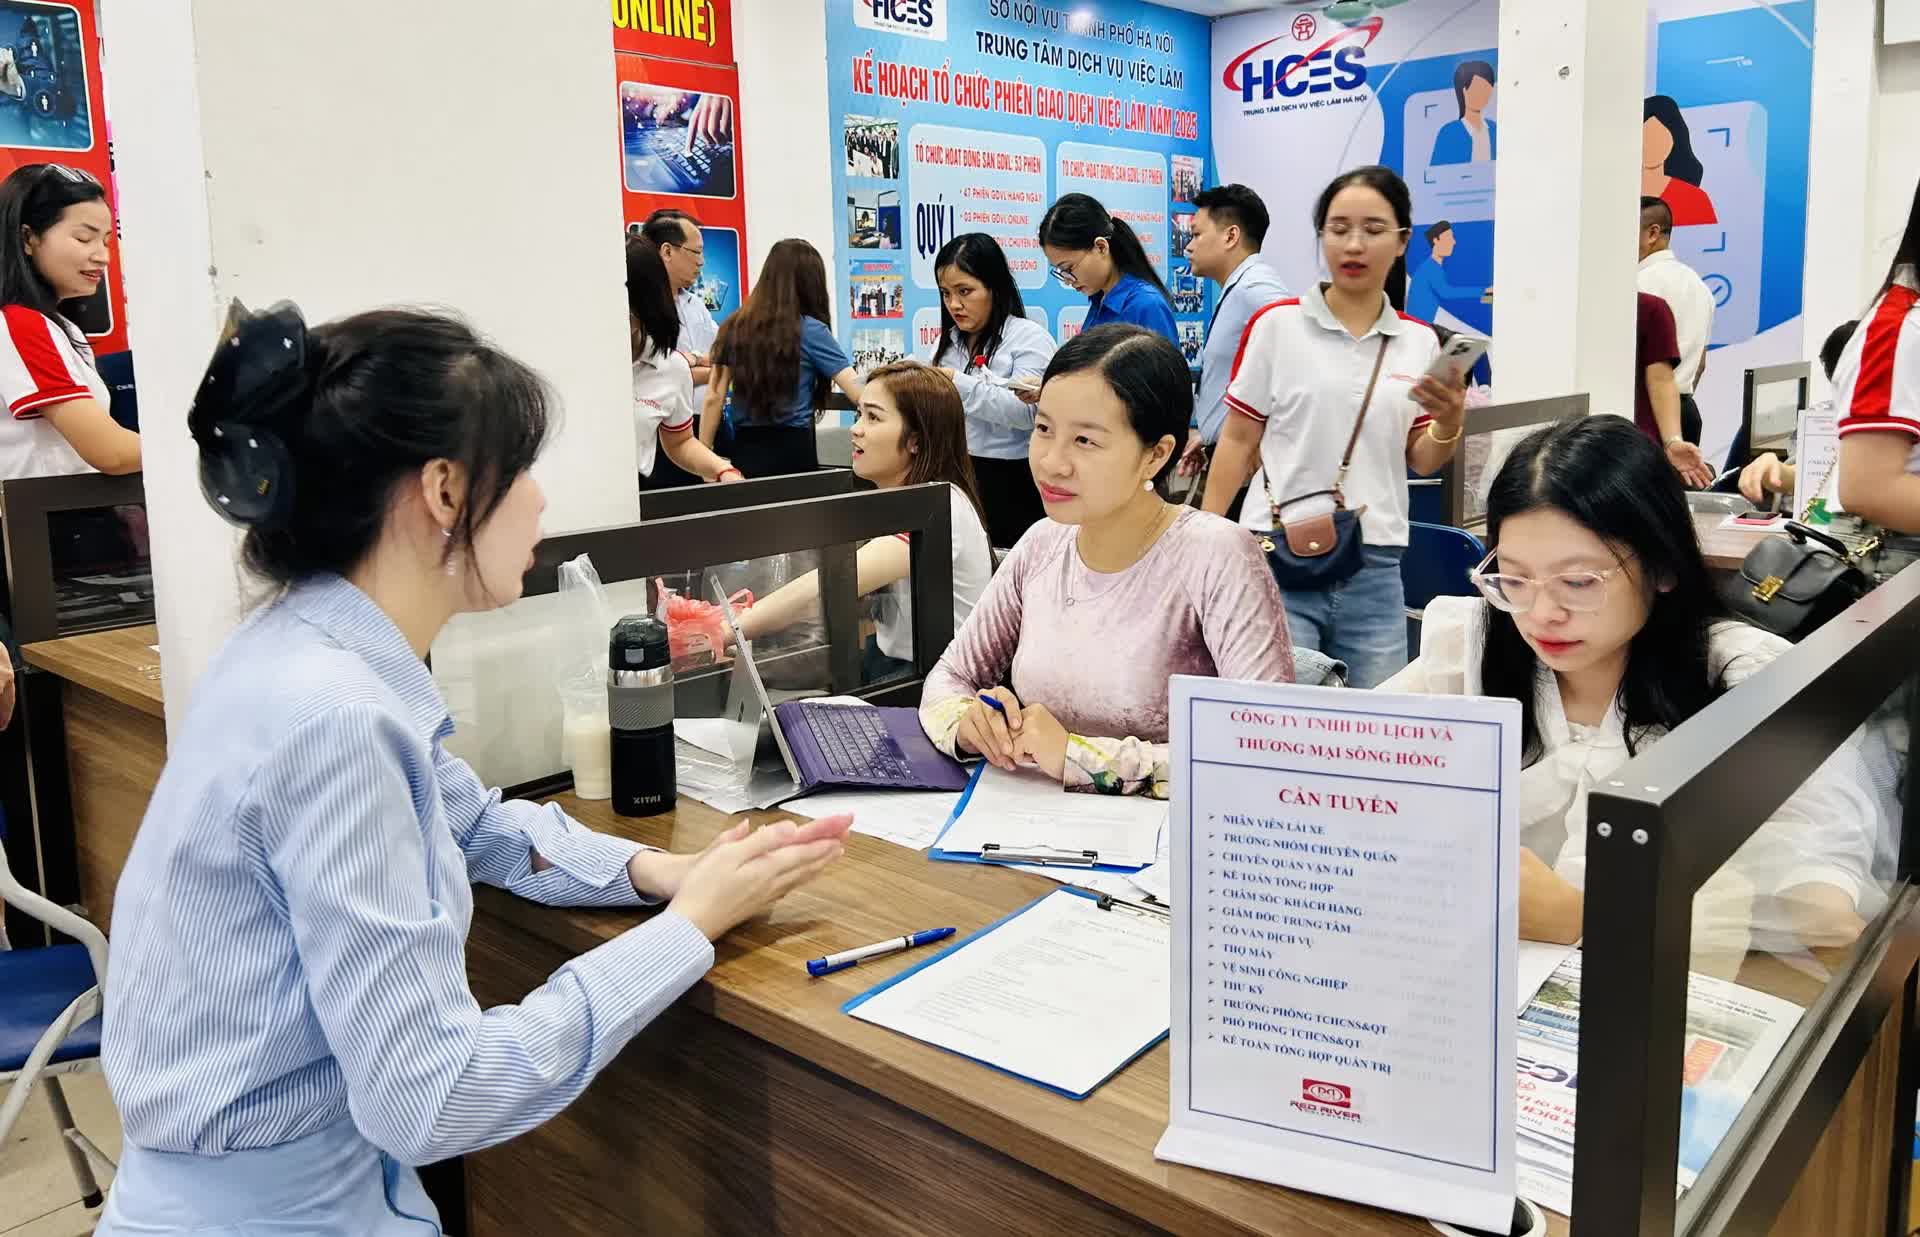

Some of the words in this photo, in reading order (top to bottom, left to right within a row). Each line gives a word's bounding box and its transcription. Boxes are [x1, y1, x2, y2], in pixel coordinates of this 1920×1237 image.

[613, 0, 716, 47] ONLINE)
[1014, 0, 1037, 28] NỘI
[1042, 9, 1059, 32] VỤ
[1110, 21, 1134, 45] PHỐ
[976, 31, 1028, 61] TRUNG
[1033, 39, 1063, 67] TÂM
[1068, 49, 1102, 77] DỊCH
[1107, 57, 1124, 83] VỤ
[1128, 59, 1156, 87] VIỆC
[1160, 64, 1183, 90] LÀM
[1242, 46, 1367, 103] HCES
[853, 49, 873, 94] KẾ
[878, 62, 929, 106] HOẠCH
[933, 59, 950, 104] TỔ
[954, 70, 990, 110] CHỨC
[994, 77, 1032, 116] PHIÊN
[1036, 86, 1064, 121] GIAO
[1068, 92, 1094, 130] DỊCH
[1098, 93, 1121, 134] VIỆC
[1124, 99, 1146, 132] LÀM
[1150, 102, 1172, 137] NĂM
[1175, 110, 1198, 140] 2025
[1243, 106, 1264, 117] TRUNG
[1266, 104, 1280, 114] TÂM
[1282, 103, 1297, 113] DỊCH
[1310, 100, 1325, 109] VIỆC
[1326, 98, 1342, 107] LÀM
[1343, 96, 1353, 105] HÀ
[1354, 94, 1367, 103] NỘI
[916, 193, 945, 260] QUÝ
[1230, 708, 1275, 726] CÔNG
[1280, 715, 1298, 727] TY
[1305, 716, 1351, 733] TNHH
[1356, 721, 1378, 734] DU
[1384, 723, 1424, 740] LỊCH
[1235, 737, 1304, 755] THƯƠNG
[1309, 745, 1341, 761] MẠI
[1345, 745, 1391, 763] SÔNG
[1279, 786, 1321, 806] CẦN
[1223, 814, 1254, 827] NHÂN
[1256, 819, 1284, 831] VIÊN
[1309, 824, 1326, 836] XE
[1222, 851, 1269, 866] CHUYÊN
[1311, 843, 1360, 858] CHUYÊN
[1309, 881, 1335, 895] HỢP
[1283, 914, 1322, 930] TRUNG
[1267, 931, 1296, 945] DỊCH
[1239, 965, 1266, 978] SINH
[1268, 968, 1301, 984] CÔNG
[1304, 975, 1350, 991] NGHIỆP
[1307, 1050, 1333, 1065] HỢP
[1290, 1099, 1317, 1112] RED
[1319, 1106, 1361, 1120] RIVER
